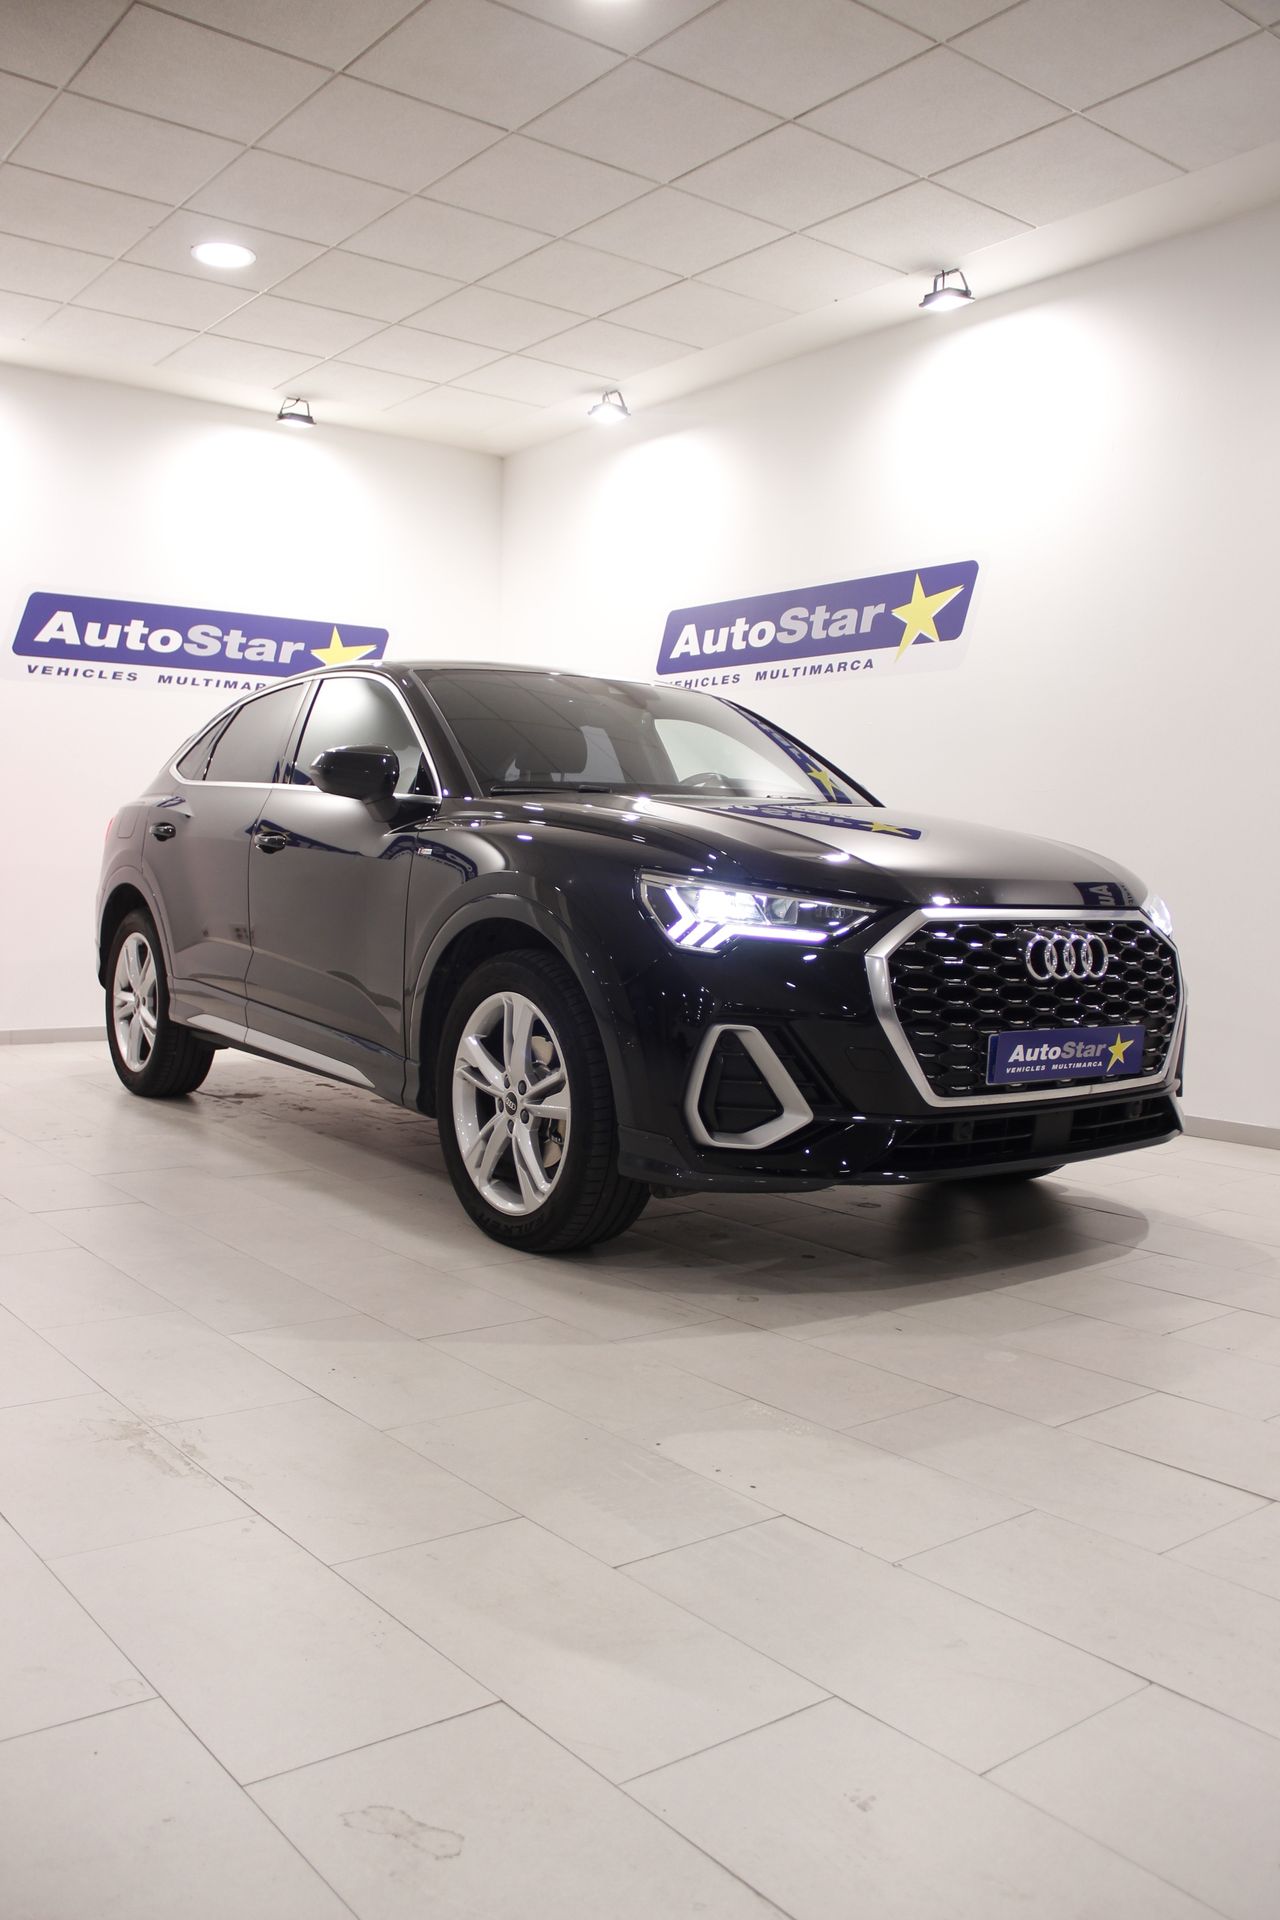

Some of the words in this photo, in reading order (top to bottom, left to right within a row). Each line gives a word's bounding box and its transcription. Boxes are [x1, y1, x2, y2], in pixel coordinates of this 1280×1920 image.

[33, 610, 305, 664] AutoStar
[669, 603, 886, 659] AutoStar
[26, 664, 138, 682] VEHICLES
[157, 674, 266, 692] MULTIMAR
[668, 673, 741, 689] EHICLES
[755, 658, 875, 681] MULTIMARCA
[1008, 1041, 1107, 1063] AutoStar
[1006, 1064, 1047, 1074] VEHICLES
[1051, 1061, 1103, 1070] MULTIMARCA
